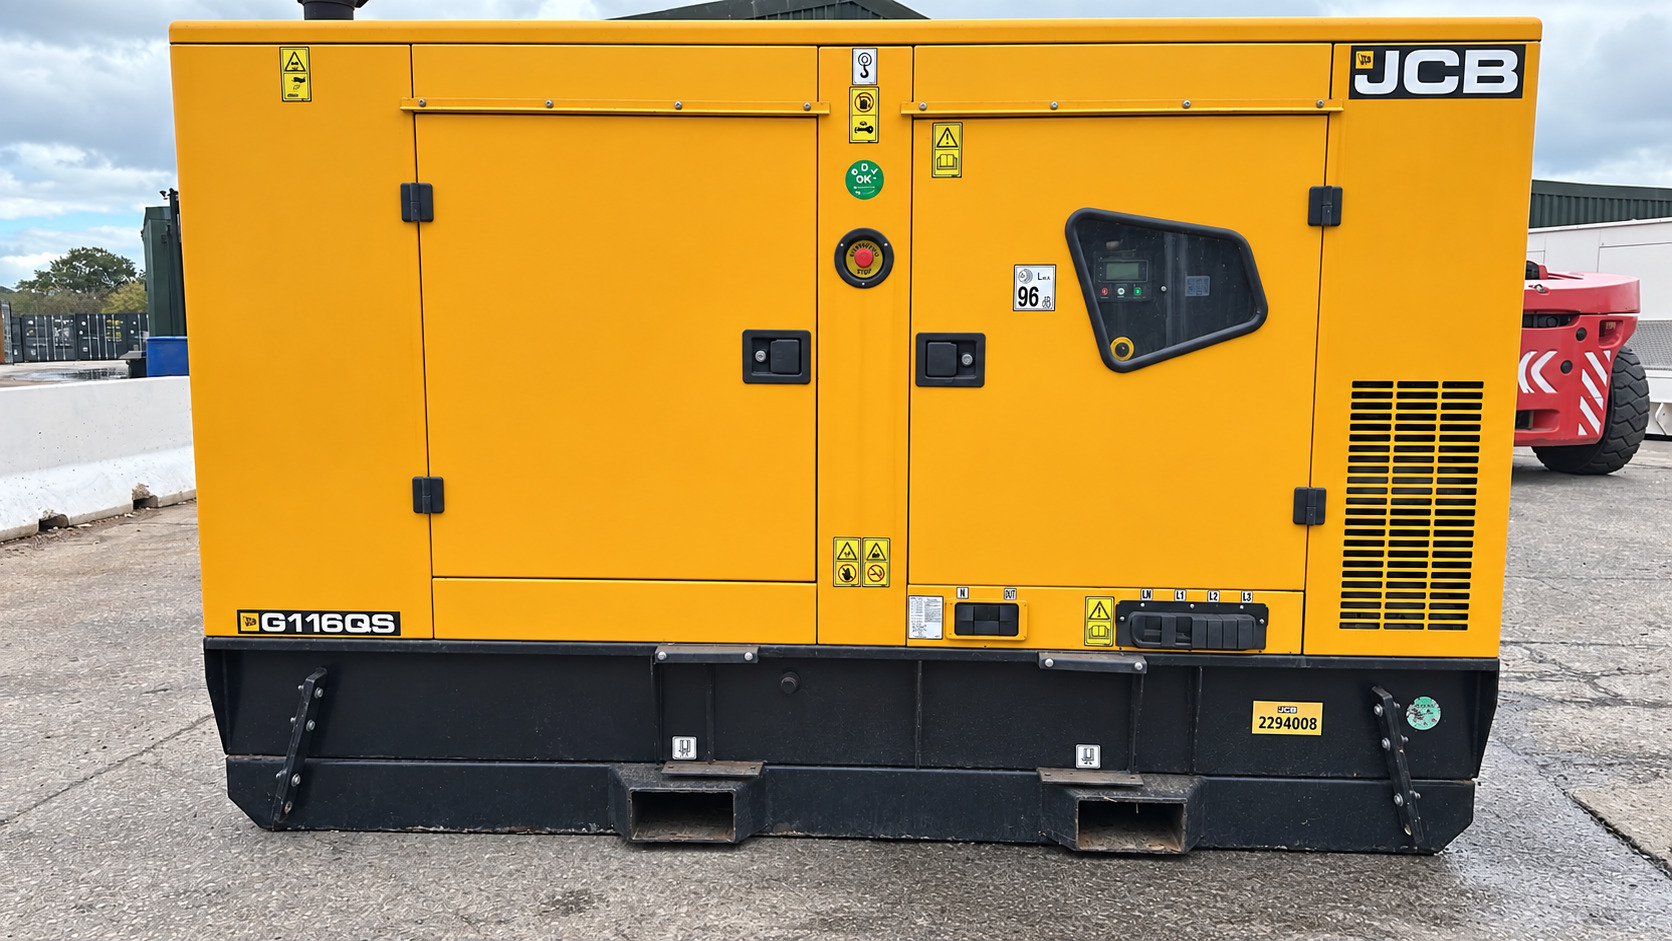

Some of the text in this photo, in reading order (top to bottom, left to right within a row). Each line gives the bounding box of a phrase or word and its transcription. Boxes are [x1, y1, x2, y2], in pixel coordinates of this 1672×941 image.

[1354, 49, 1519, 95] JCB
[856, 174, 872, 184] OK
[1018, 285, 1040, 307] 96
[1176, 590, 1184, 600] L1
[1209, 591, 1218, 601] L2
[1242, 591, 1252, 602] L3
[260, 612, 396, 634] G116QS
[1277, 706, 1298, 714] JCB
[1258, 716, 1318, 731] 2294008
